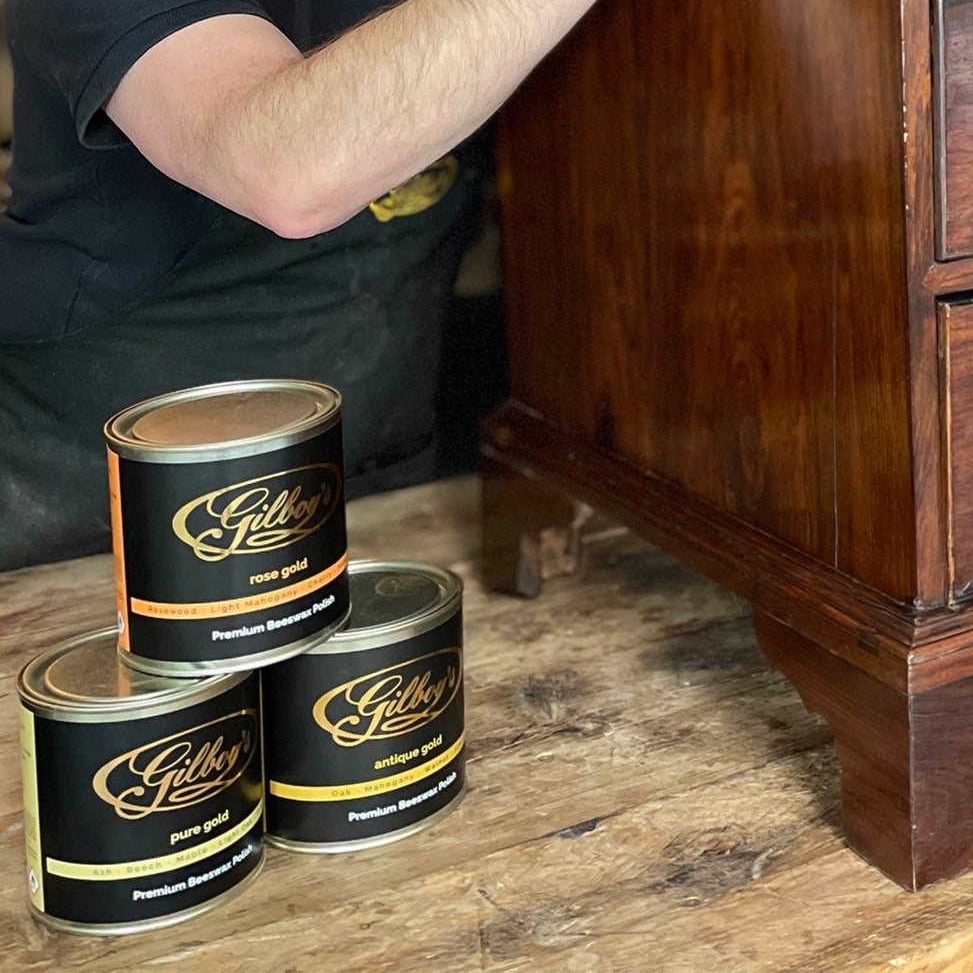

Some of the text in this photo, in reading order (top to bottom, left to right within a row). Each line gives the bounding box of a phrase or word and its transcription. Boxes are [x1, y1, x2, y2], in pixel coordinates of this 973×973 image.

[192, 481, 333, 562] Gilboy's
[249, 557, 308, 585] rose gold
[210, 603, 240, 613] Light
[244, 589, 298, 607] Mahogany
[212, 594, 335, 641] Premium Beeswax Polish
[374, 748, 420, 770] antique
[420, 733, 443, 756] gold
[331, 789, 351, 797] Oak
[348, 804, 397, 822] Premium
[398, 786, 438, 810] Beeswax
[170, 825, 202, 845] pure
[203, 809, 230, 833] gold
[133, 881, 186, 901] Premium
[187, 861, 232, 888] Beeswax
